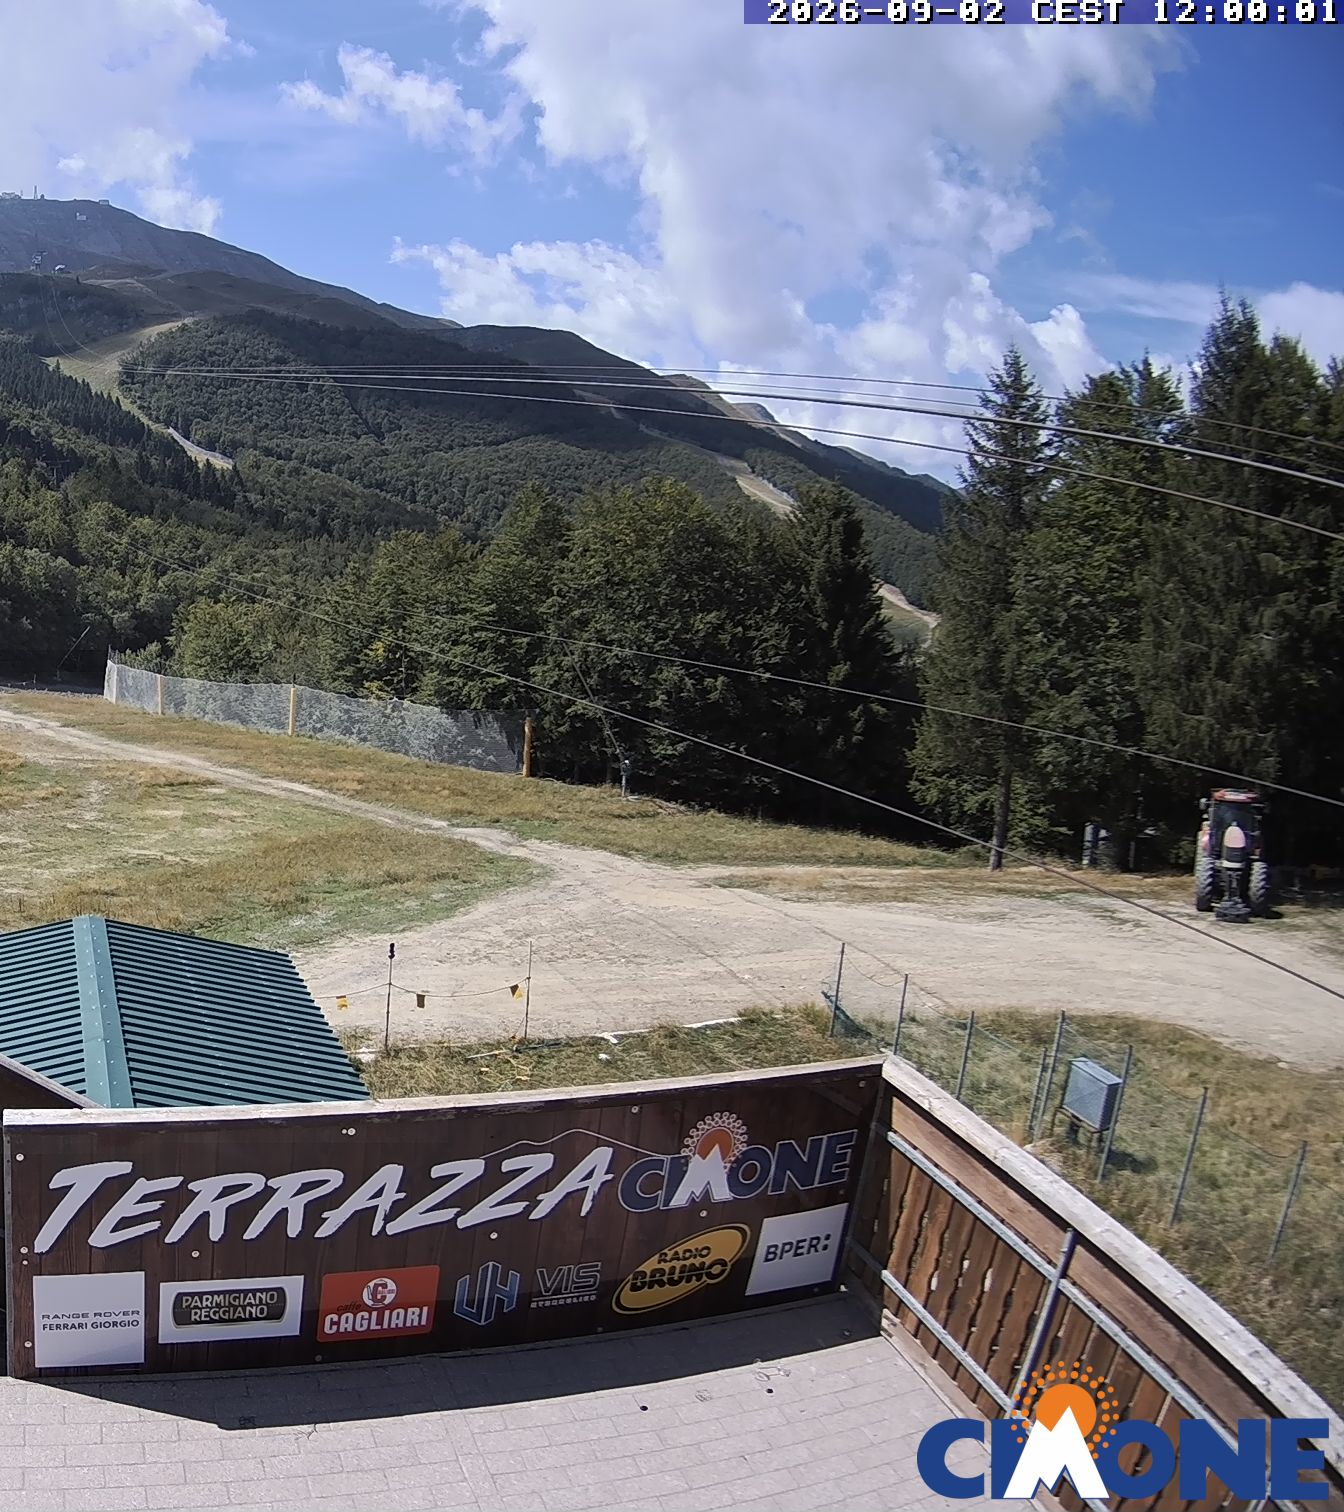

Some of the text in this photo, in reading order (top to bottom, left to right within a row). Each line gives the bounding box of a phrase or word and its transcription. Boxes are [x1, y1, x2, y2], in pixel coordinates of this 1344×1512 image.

[33, 1128, 859, 1254] TERRAZZA CIMONE
[657, 1245, 712, 1265] RADIO
[536, 1262, 602, 1296] VIS
[629, 1258, 729, 1293] BRUNO
[181, 1291, 278, 1309] PARMIGIANO
[41, 1310, 141, 1321] RANGE ROVER
[191, 1305, 268, 1322] REGGIANO
[323, 1305, 429, 1334] CAGLIARI
[42, 1319, 140, 1331] FERRARI GIORGIO
